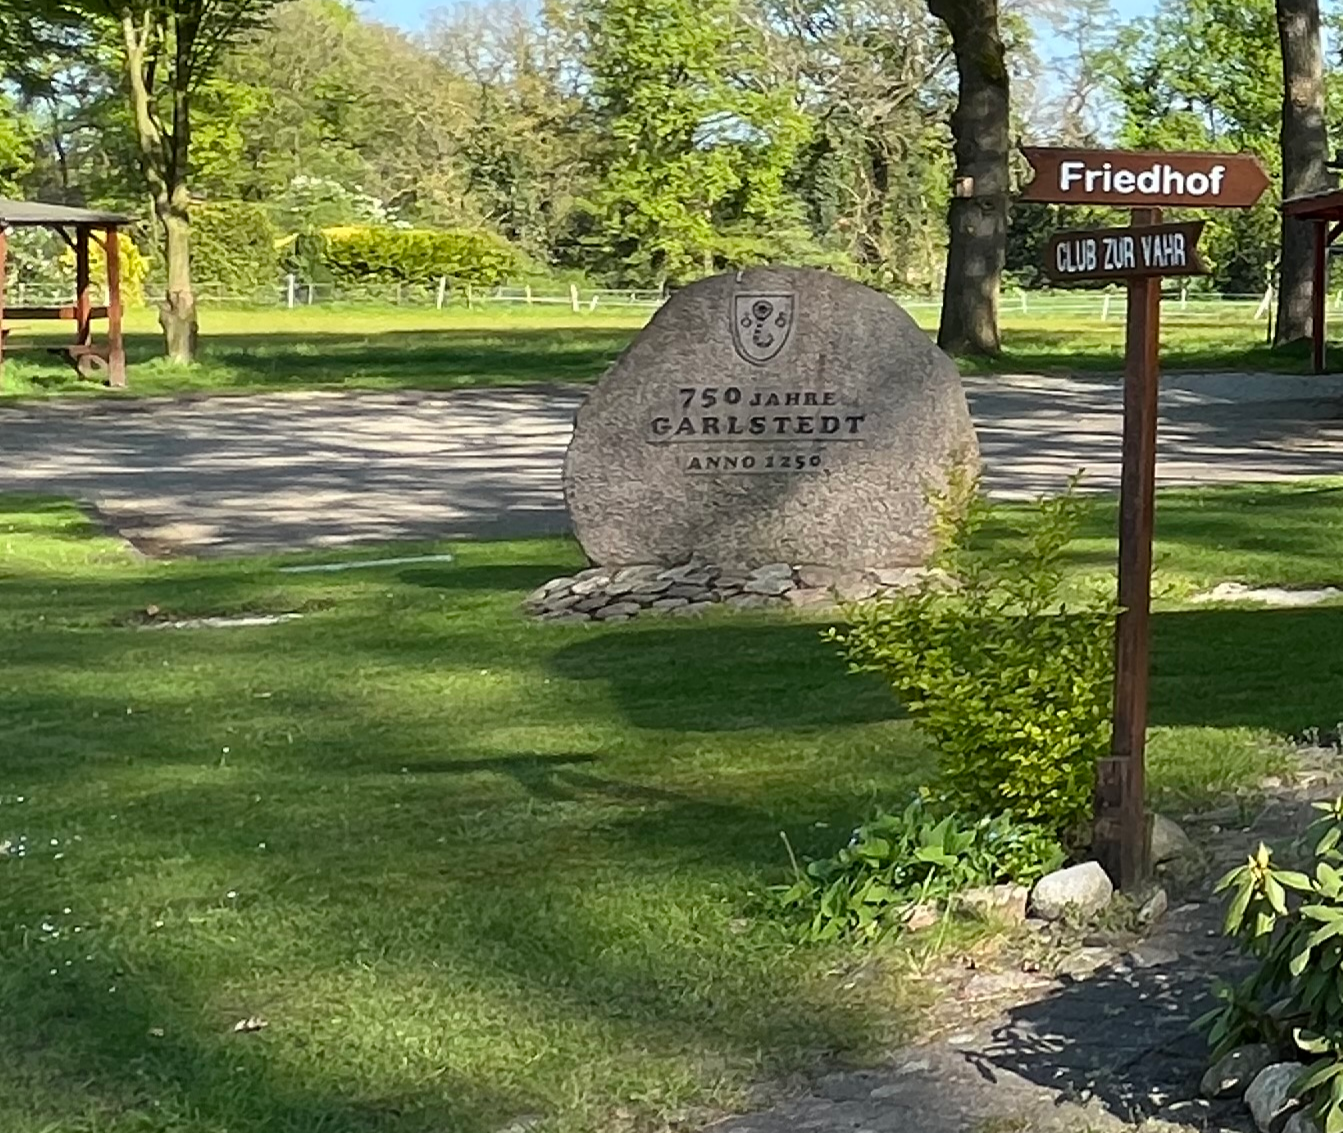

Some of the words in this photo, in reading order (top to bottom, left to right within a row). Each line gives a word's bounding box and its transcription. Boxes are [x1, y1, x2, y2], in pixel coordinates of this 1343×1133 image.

[1059, 161, 1227, 195] Friedhof
[1056, 238, 1097, 273] CLUB
[1103, 236, 1136, 271] ZUR
[1141, 233, 1187, 267] VAHR
[679, 387, 742, 408] 750
[750, 392, 837, 406] JAHRE
[650, 415, 865, 435] GARLSTEDT
[688, 456, 756, 470] ANNO
[765, 454, 822, 470] 1250
